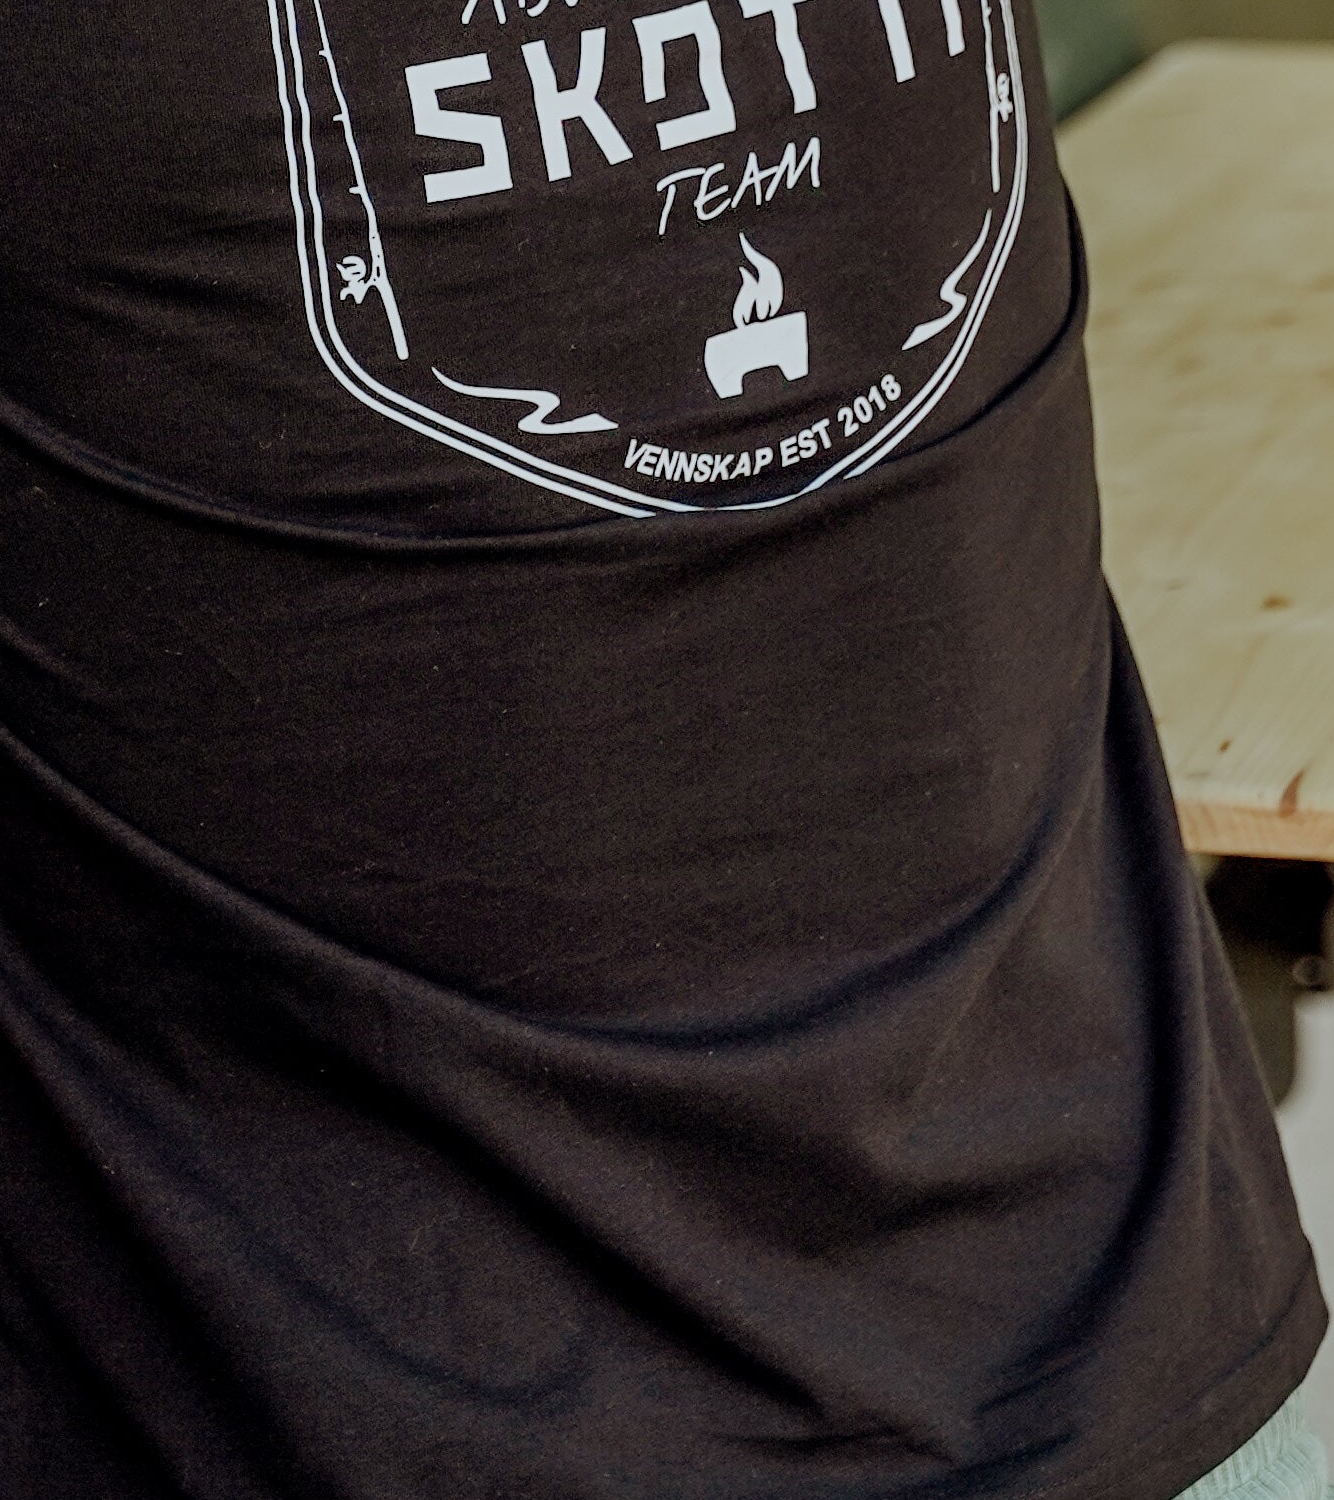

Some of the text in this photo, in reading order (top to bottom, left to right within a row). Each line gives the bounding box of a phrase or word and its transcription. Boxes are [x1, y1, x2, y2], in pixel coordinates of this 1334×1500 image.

[656, 136, 821, 236] TEAM
[623, 373, 902, 483] VENNSKAP EST 2018
